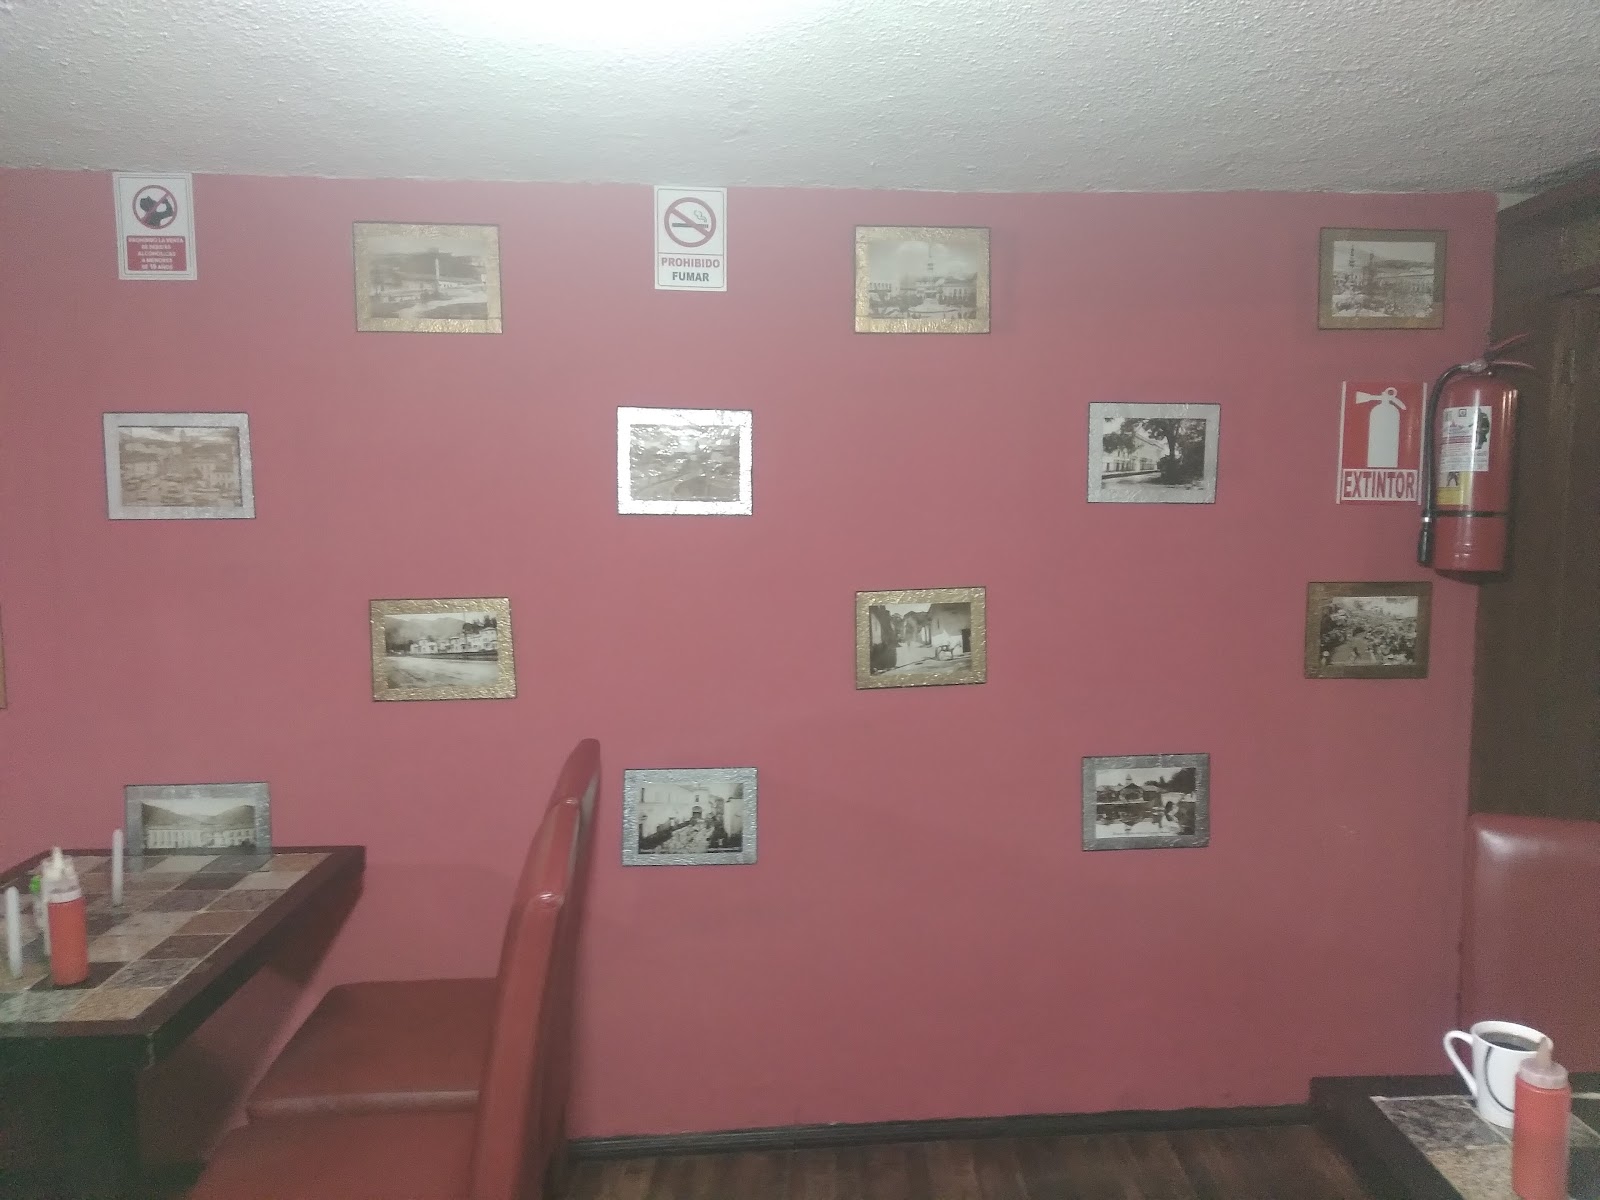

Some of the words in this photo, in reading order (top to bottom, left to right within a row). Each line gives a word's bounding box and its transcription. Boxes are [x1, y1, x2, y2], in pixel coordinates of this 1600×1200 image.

[661, 257, 721, 268] PROHIBIDO
[672, 271, 710, 282] FUMAR
[1343, 471, 1416, 498] EXTINTOR
